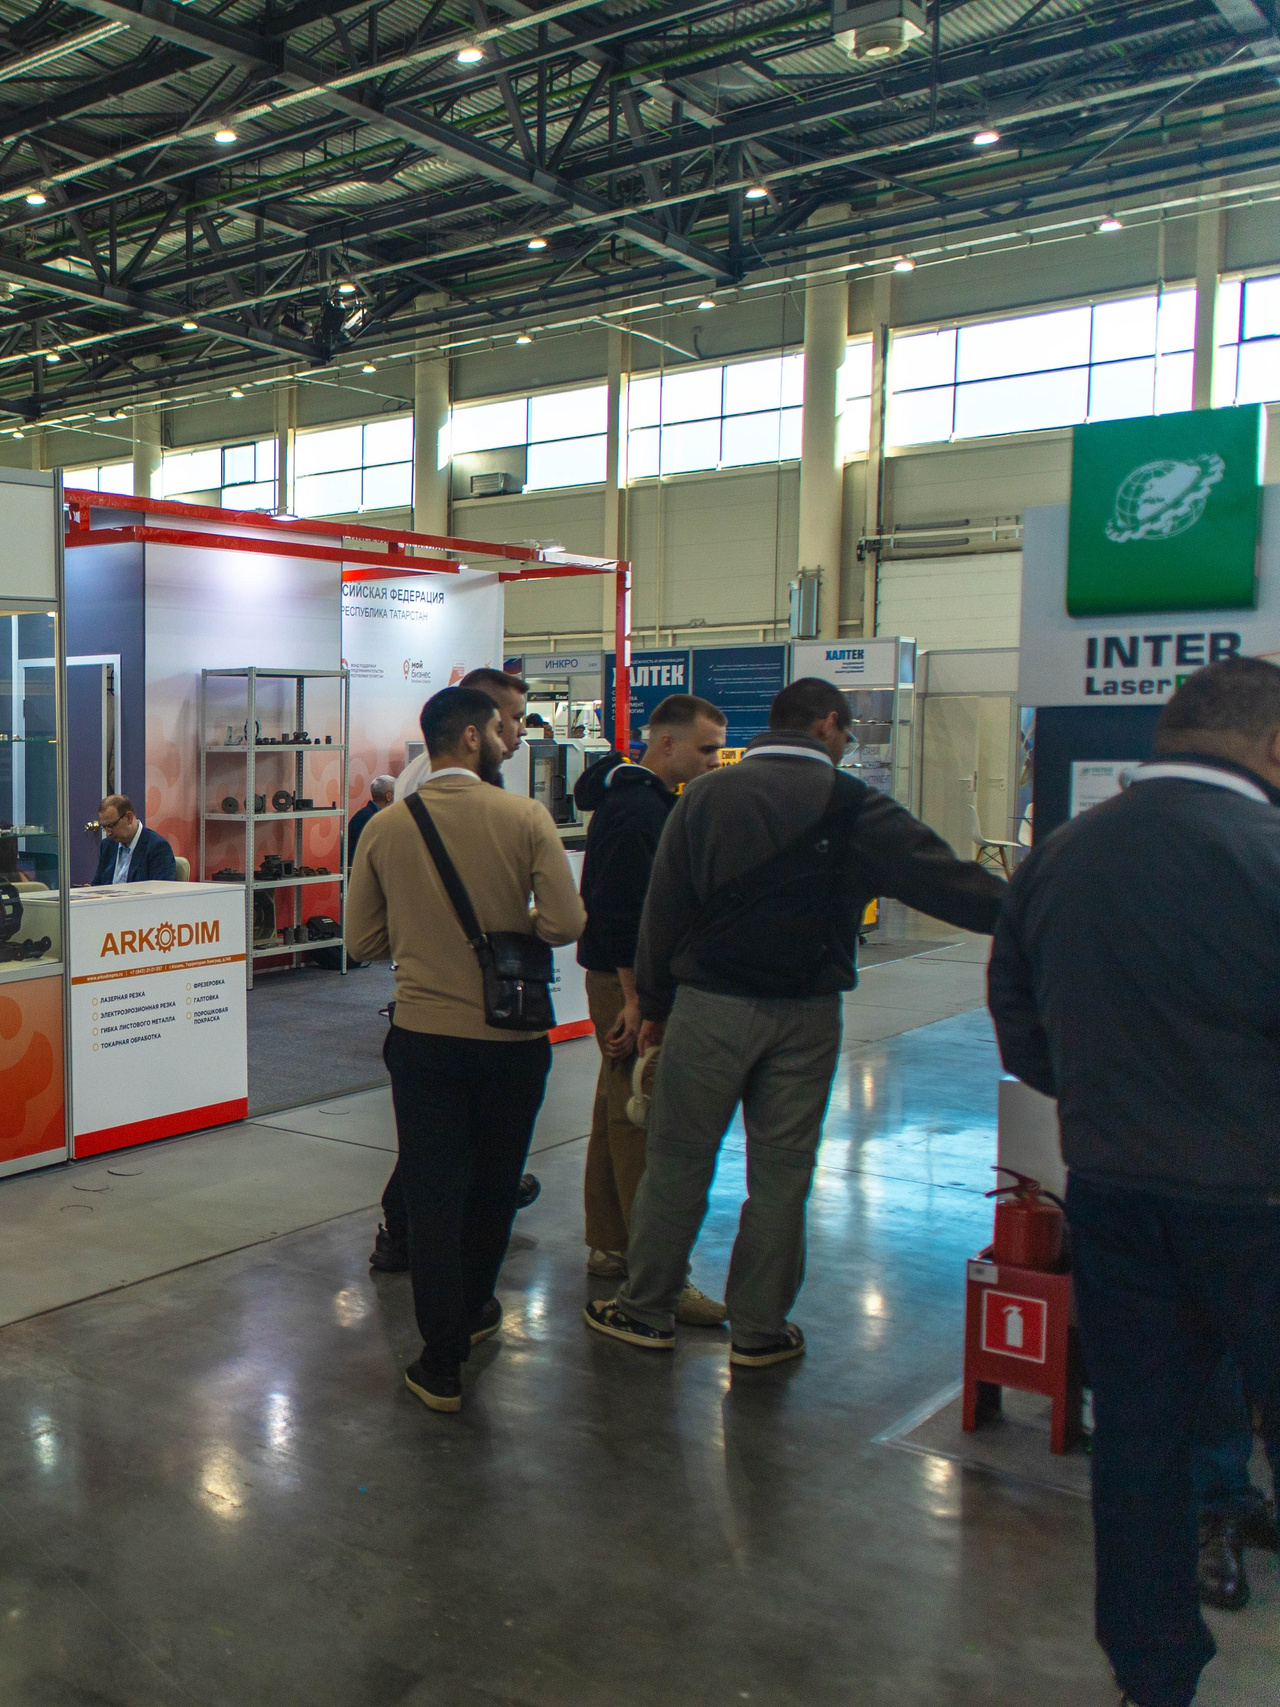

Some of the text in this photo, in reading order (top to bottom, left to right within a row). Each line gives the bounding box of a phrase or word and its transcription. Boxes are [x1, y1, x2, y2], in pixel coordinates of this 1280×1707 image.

[342, 582, 445, 605] СИЙСКАЯ ФЕДЕРАЦИЯ
[342, 605, 429, 621] РЕСПУБЛИКА ТАТАРСТАН
[825, 649, 865, 661] ХАЛТЕК
[1086, 631, 1243, 670] INTER
[411, 660, 424, 669] мой
[545, 658, 579, 669] ИНКРО
[411, 669, 432, 679] бизнес
[100, 920, 220, 957] ARKODIM
[193, 979, 226, 989] ФРЕЗЕРОВКА
[100, 991, 146, 1004] ЛАЗЕРНАЯ РЕЗКА
[193, 994, 220, 1004] ГАЛТОВКА
[100, 1001, 177, 1019] ЭЛЕКТРОЭРОЗИОННАЯ РЕЗКА
[193, 1006, 229, 1018] ПОРОШКОВАЯ
[100, 1015, 176, 1034] ГИБКА ЛИСТОВОГО МЕТАЛЛА
[193, 1015, 221, 1025] ПОКРАСКА
[100, 1033, 162, 1050] ТОКАРНАЯ ОБРАБОТКА
